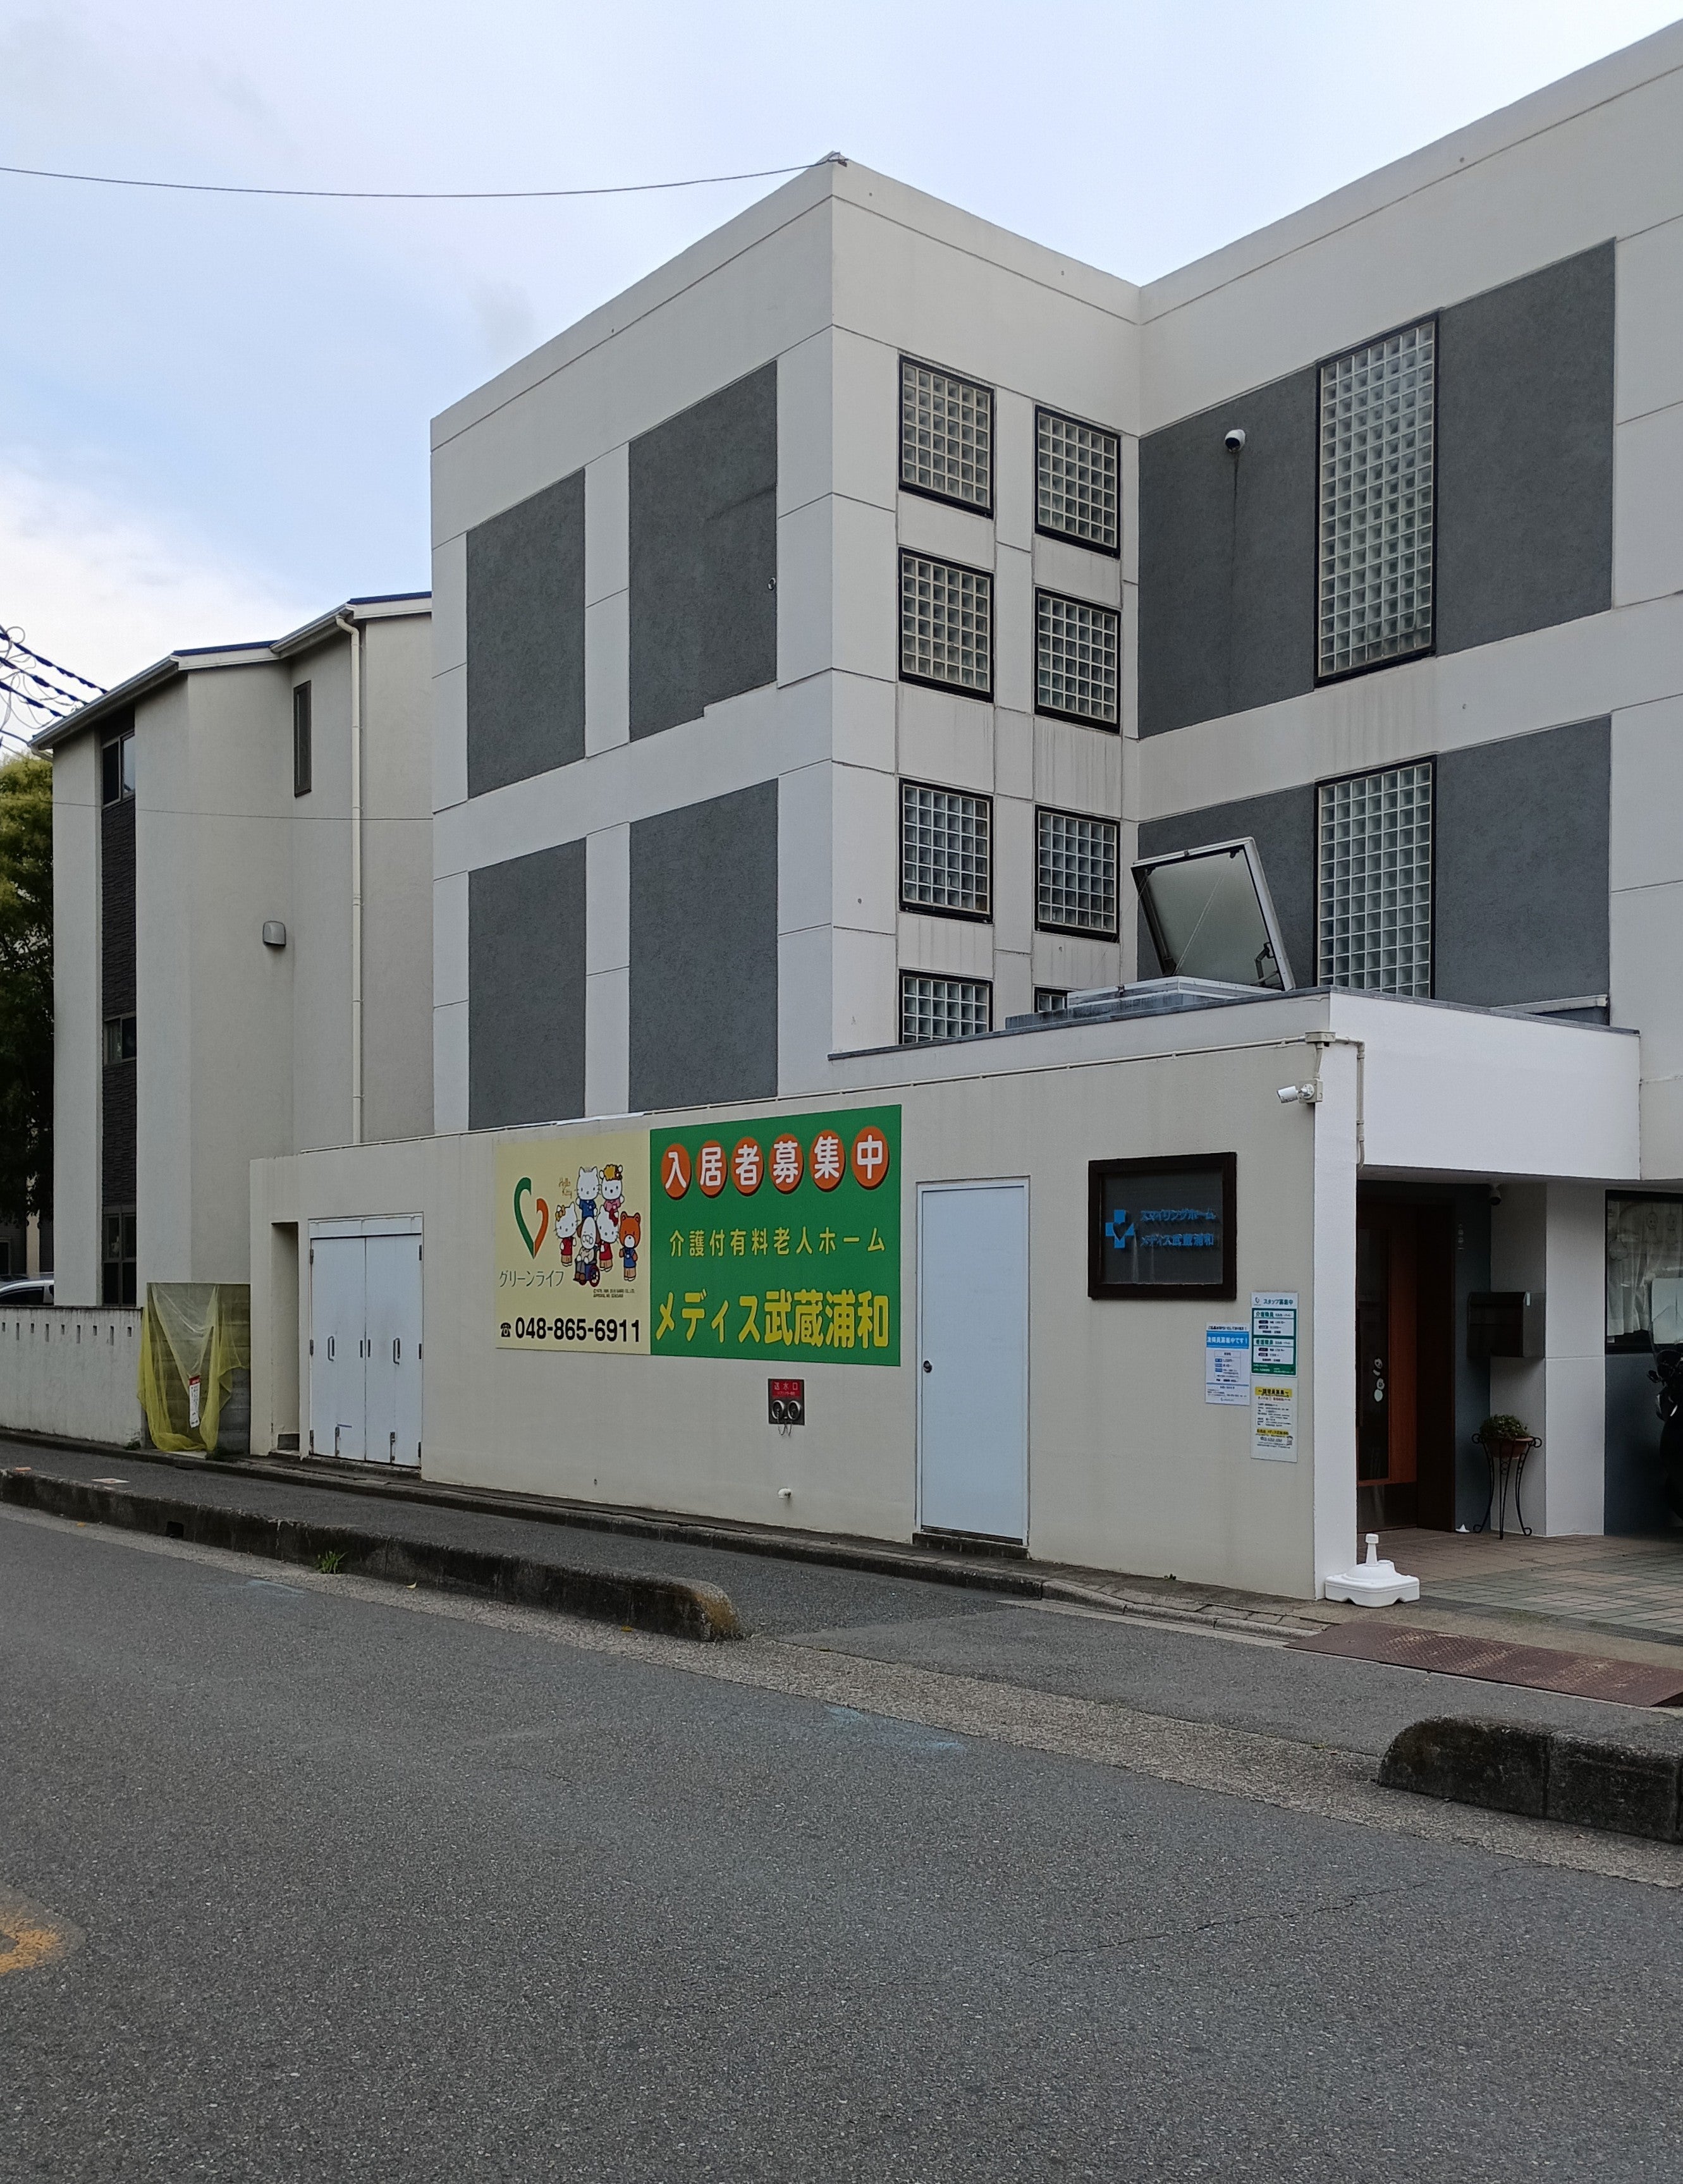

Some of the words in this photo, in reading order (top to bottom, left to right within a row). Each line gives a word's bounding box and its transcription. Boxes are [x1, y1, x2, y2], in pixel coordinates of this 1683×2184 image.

[665, 1135, 883, 1189] 入居者募集中
[670, 1226, 885, 1257] 介護付有料老人ホーム
[499, 1270, 564, 1288] グリーンライフ
[515, 1317, 639, 1343] 048-865-6911
[656, 1288, 888, 1349] メディス武蔵浦和
